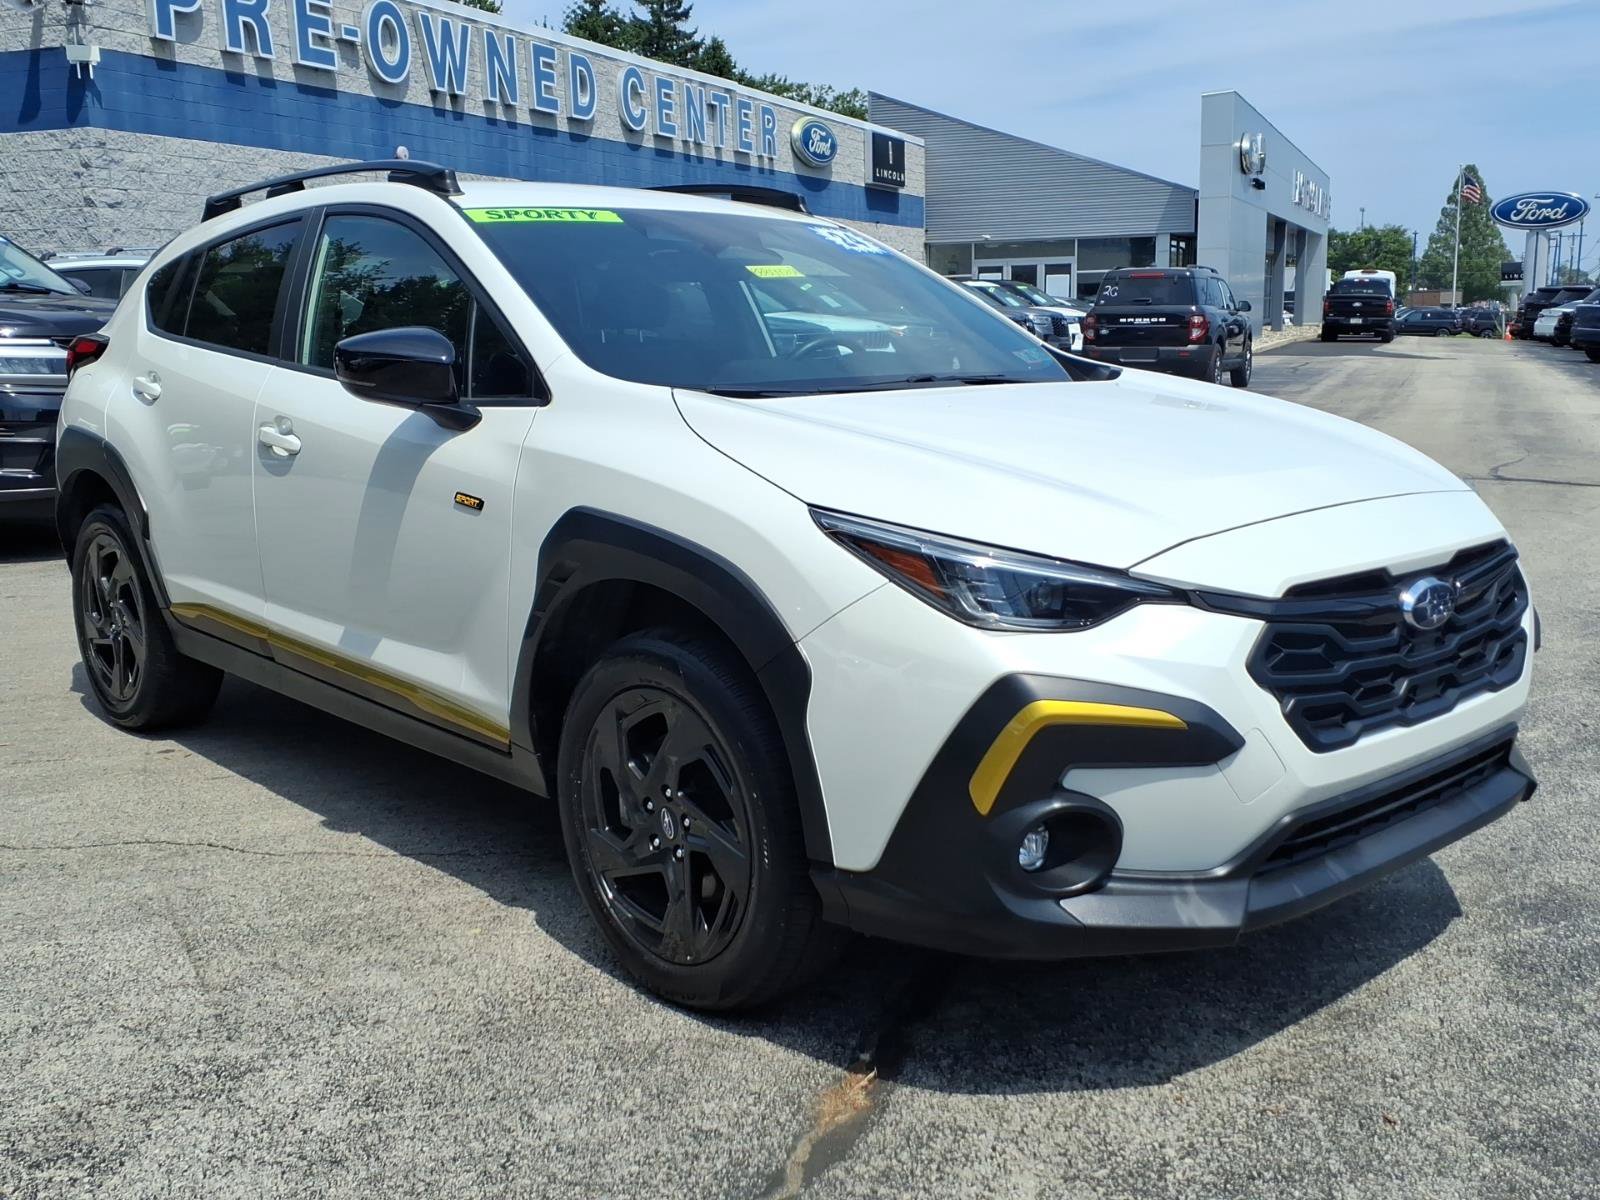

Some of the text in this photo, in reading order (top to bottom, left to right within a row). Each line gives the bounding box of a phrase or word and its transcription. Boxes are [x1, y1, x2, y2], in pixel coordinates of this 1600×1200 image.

[618, 65, 778, 158] CENTER
[808, 127, 831, 156] Ford
[876, 167, 905, 182] LINCOLN
[485, 209, 597, 220] SPORTY
[1510, 198, 1568, 221] Ford
[455, 494, 480, 507] SPORT
